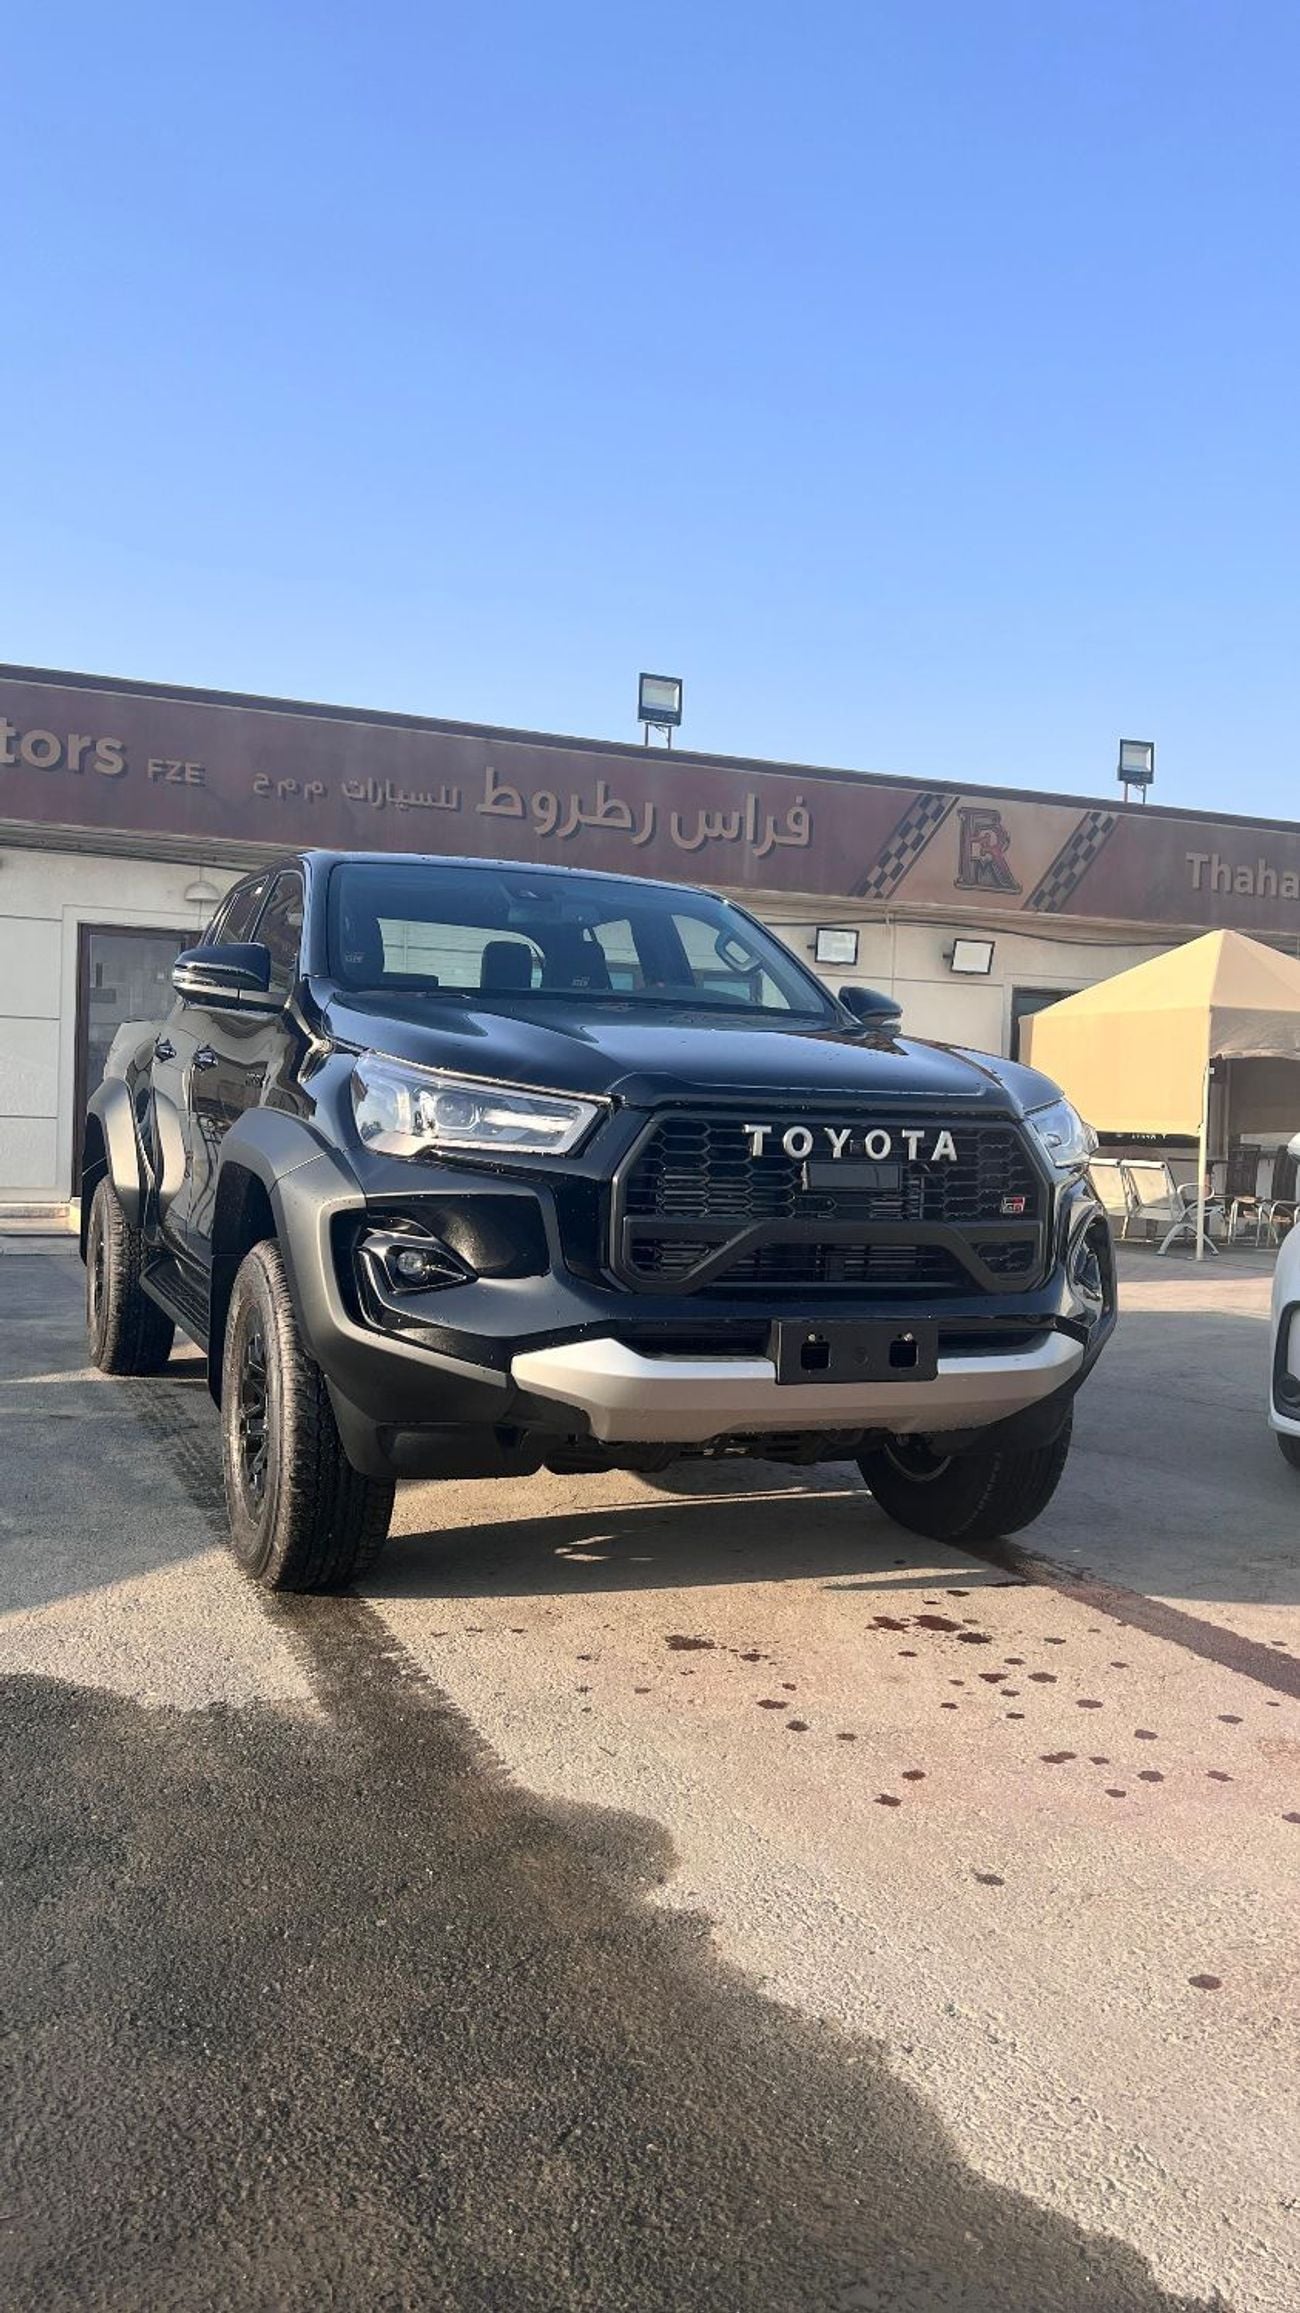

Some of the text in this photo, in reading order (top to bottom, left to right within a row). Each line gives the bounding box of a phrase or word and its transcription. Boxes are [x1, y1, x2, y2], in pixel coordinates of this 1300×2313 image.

[147, 758, 203, 784] FZE
[342, 776, 459, 812] للسيارات
[475, 766, 655, 846] رطروط
[670, 794, 811, 857] فراس
[744, 1124, 958, 1161] TOYOTA
